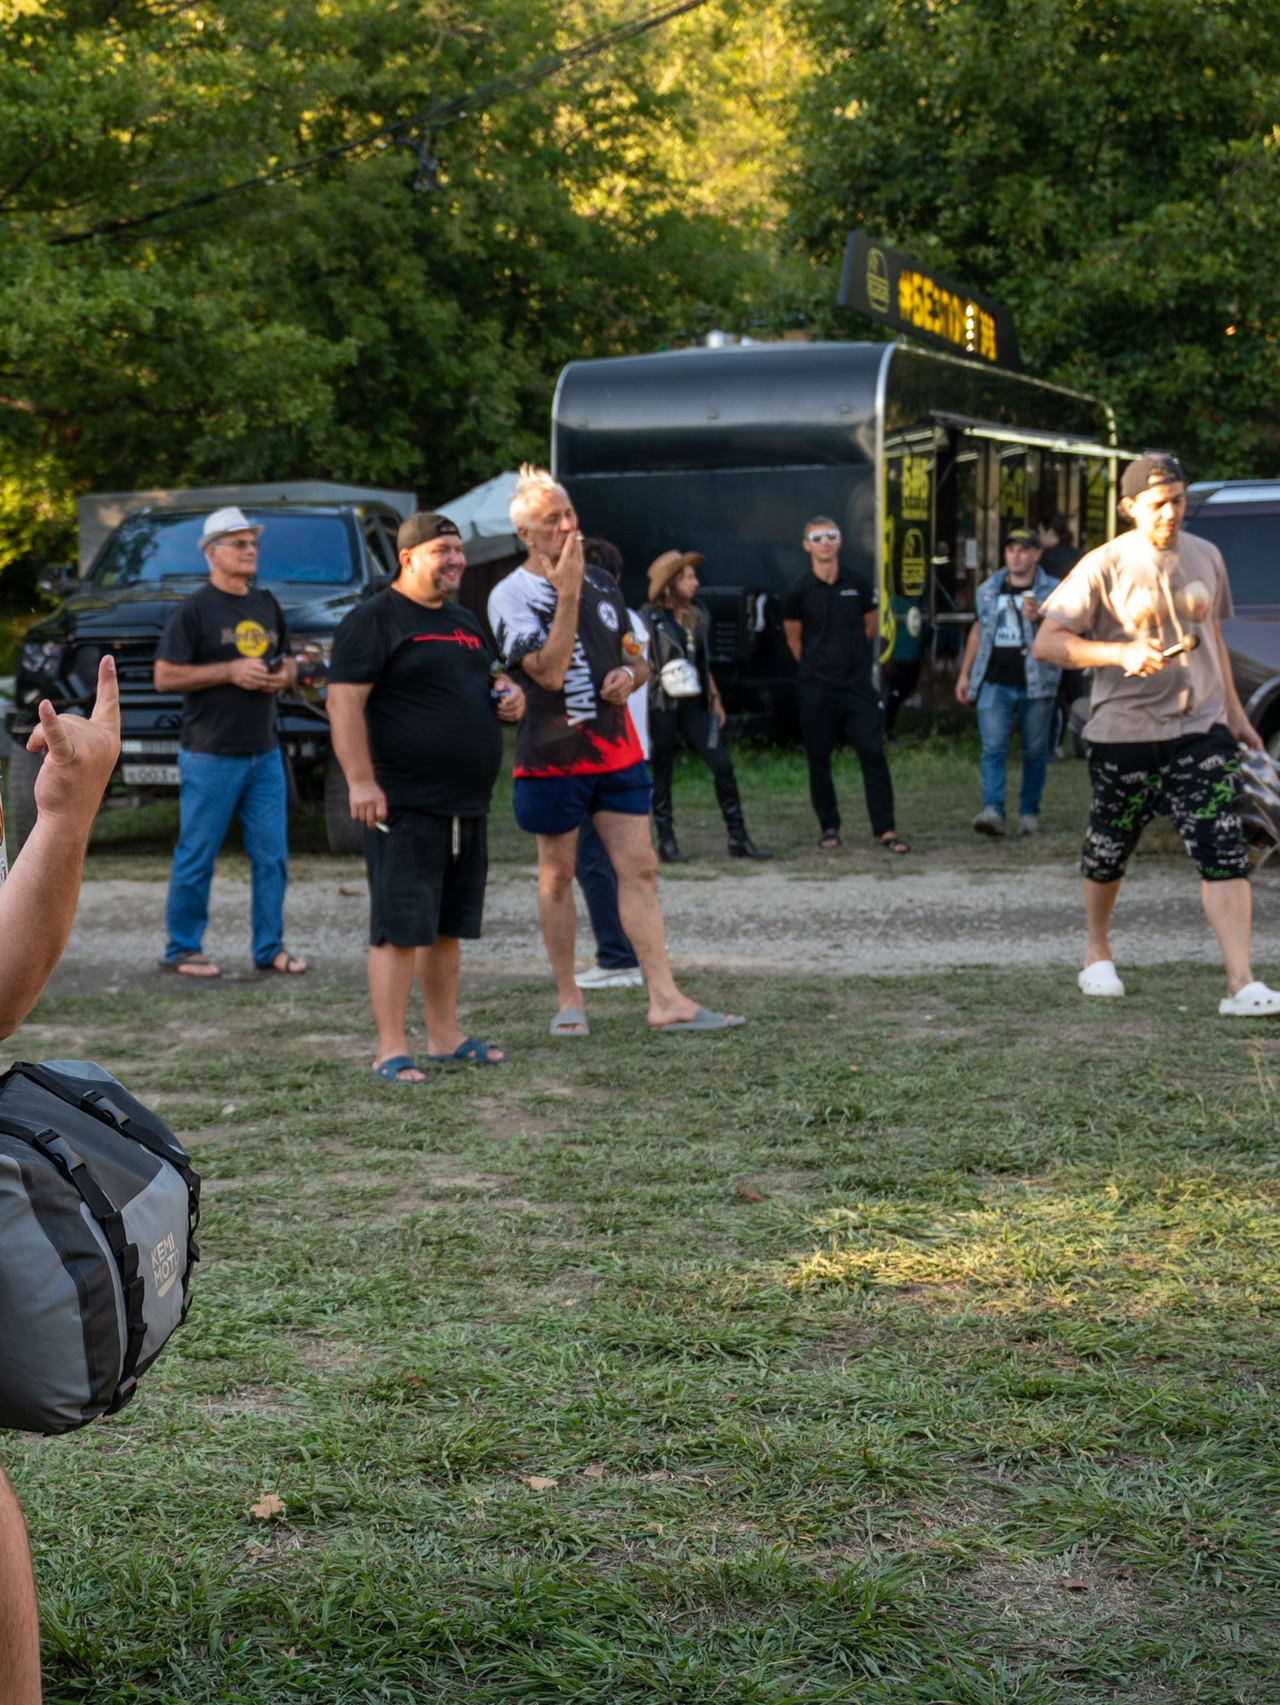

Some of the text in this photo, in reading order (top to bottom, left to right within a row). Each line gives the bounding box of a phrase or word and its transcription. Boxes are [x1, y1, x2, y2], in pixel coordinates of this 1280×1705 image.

[564, 632, 597, 727] YAMA
[151, 1231, 176, 1269] KEMI
[153, 1247, 180, 1288] MOTO
